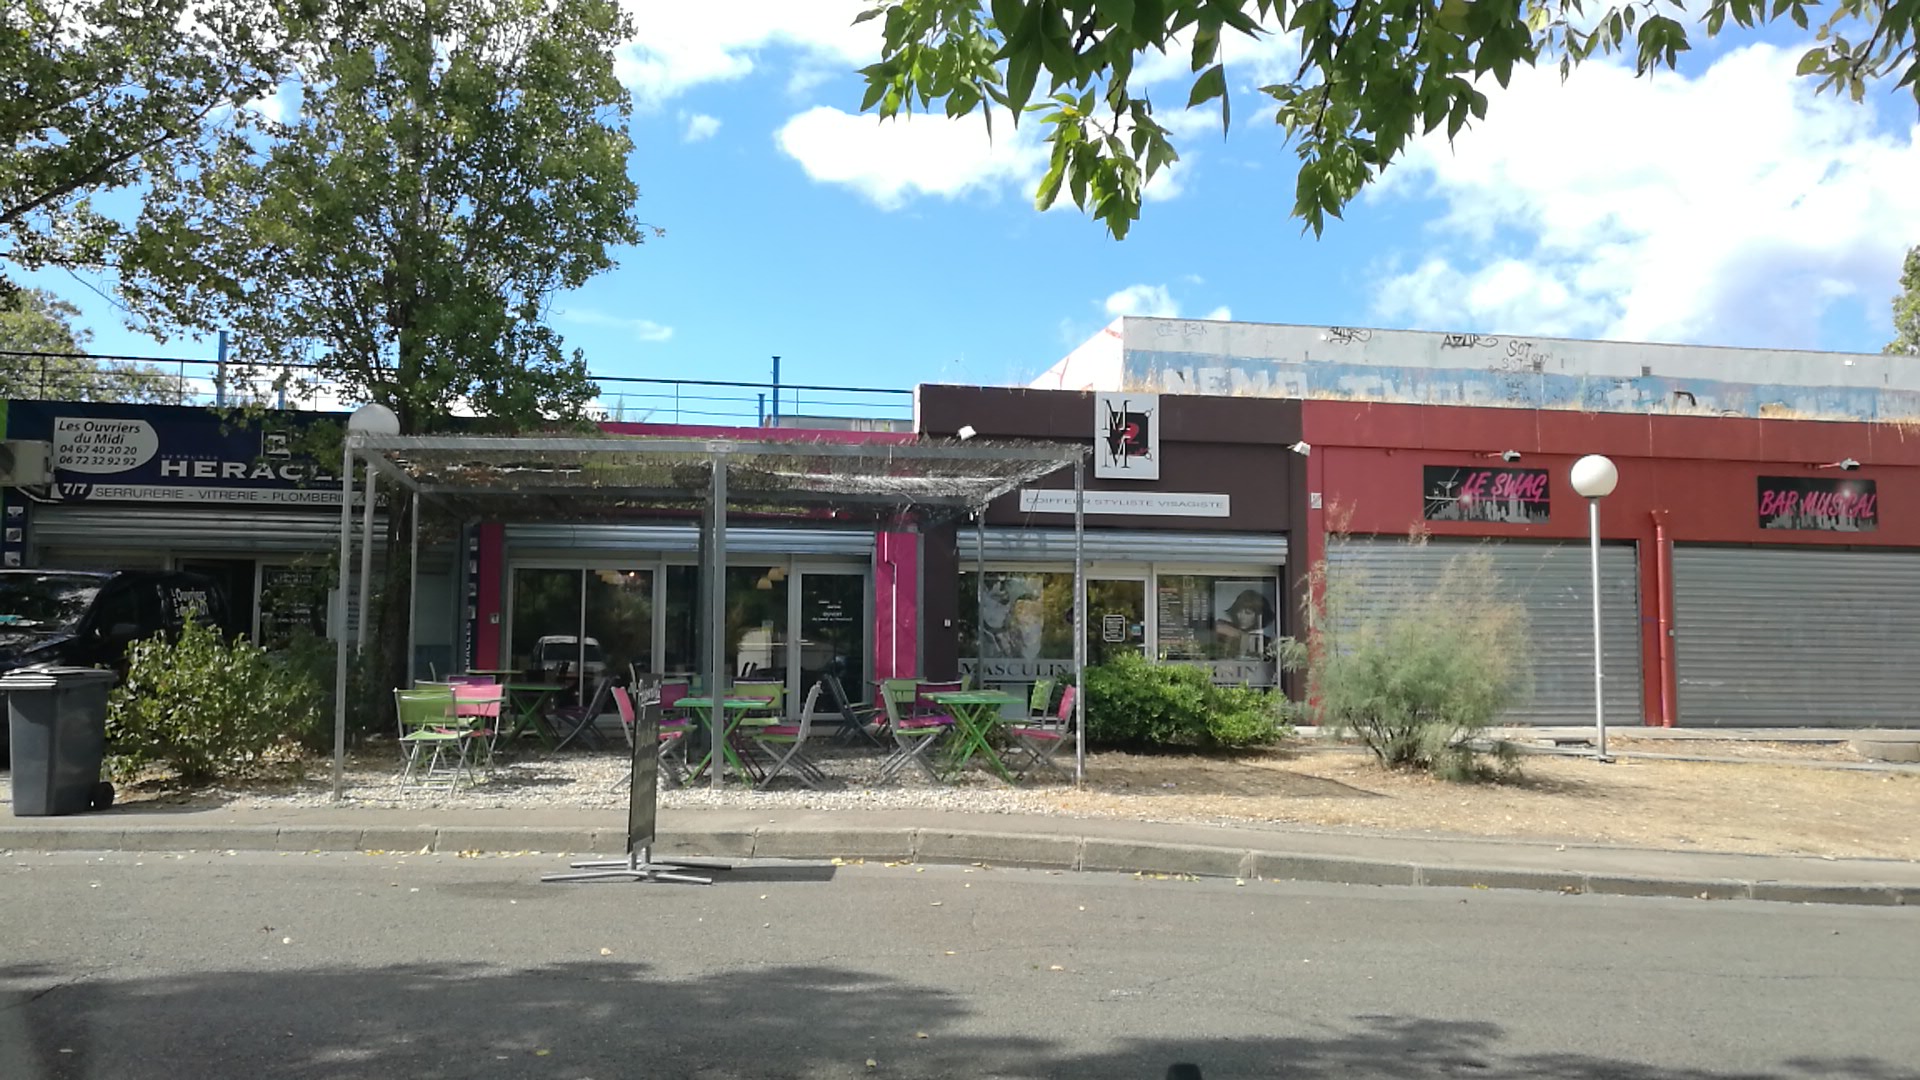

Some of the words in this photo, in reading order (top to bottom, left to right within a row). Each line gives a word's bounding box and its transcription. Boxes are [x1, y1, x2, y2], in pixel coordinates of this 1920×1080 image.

[58, 420, 80, 432] Les
[84, 421, 141, 433] Ouvriers
[74, 432, 92, 444] du
[94, 433, 125, 445] Midi
[59, 444, 74, 453] 04
[76, 445, 90, 453] 67
[92, 445, 106, 454] 40
[107, 446, 122, 455] 20
[123, 446, 137, 455] 20
[59, 456, 73, 464] 06
[76, 456, 89, 465] 72
[91, 457, 105, 465] 32
[107, 457, 121, 466] 92
[123, 457, 137, 466] 92
[63, 483, 88, 496] 7/7
[1461, 472, 1492, 495] LE
[1491, 472, 1547, 503] SWAG
[95, 487, 184, 499] SERRURERIE
[197, 490, 257, 501] VITRERIE
[272, 491, 345, 503] PLOMBERI
[1094, 498, 1153, 507] STYLISTE
[1157, 500, 1224, 509] VISAGISTE
[1759, 490, 1799, 516] BAR
[962, 662, 1070, 677] MASCULIN
